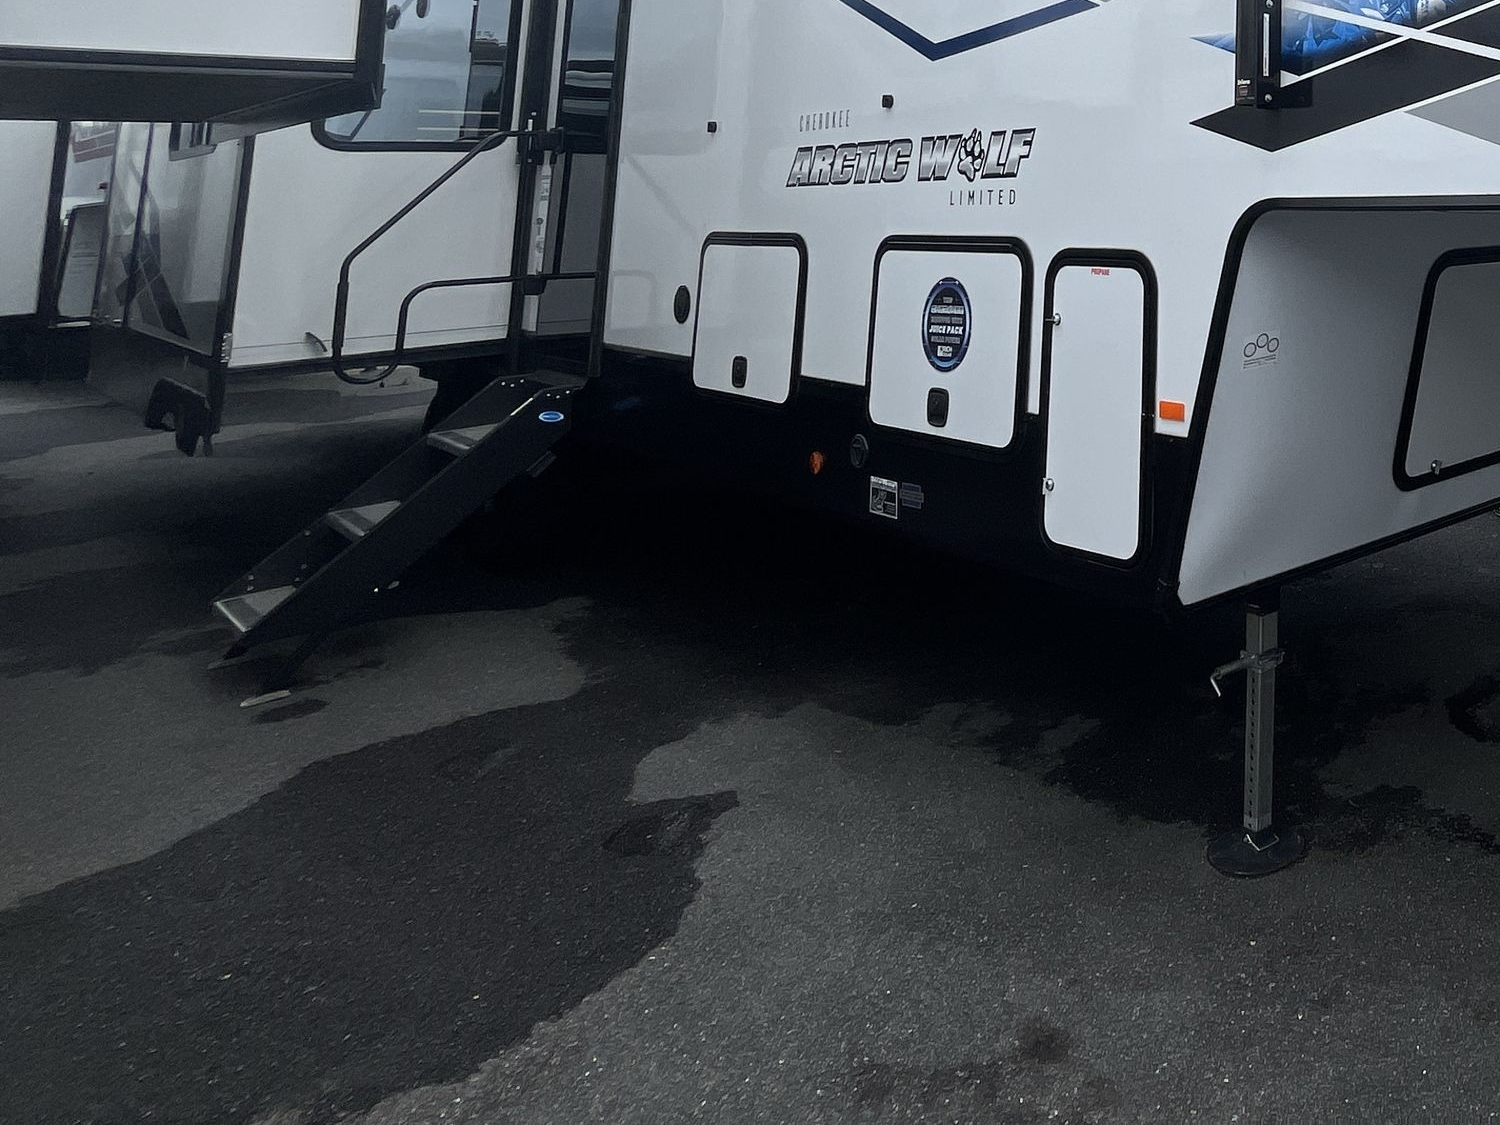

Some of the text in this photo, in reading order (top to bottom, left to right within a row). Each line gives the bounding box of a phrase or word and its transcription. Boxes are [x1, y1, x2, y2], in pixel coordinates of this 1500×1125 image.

[799, 109, 850, 132] CHEROKEE
[786, 138, 913, 187] ARCTIC
[950, 189, 1016, 206] LIMITED
[929, 324, 964, 335] JUICE PACK
